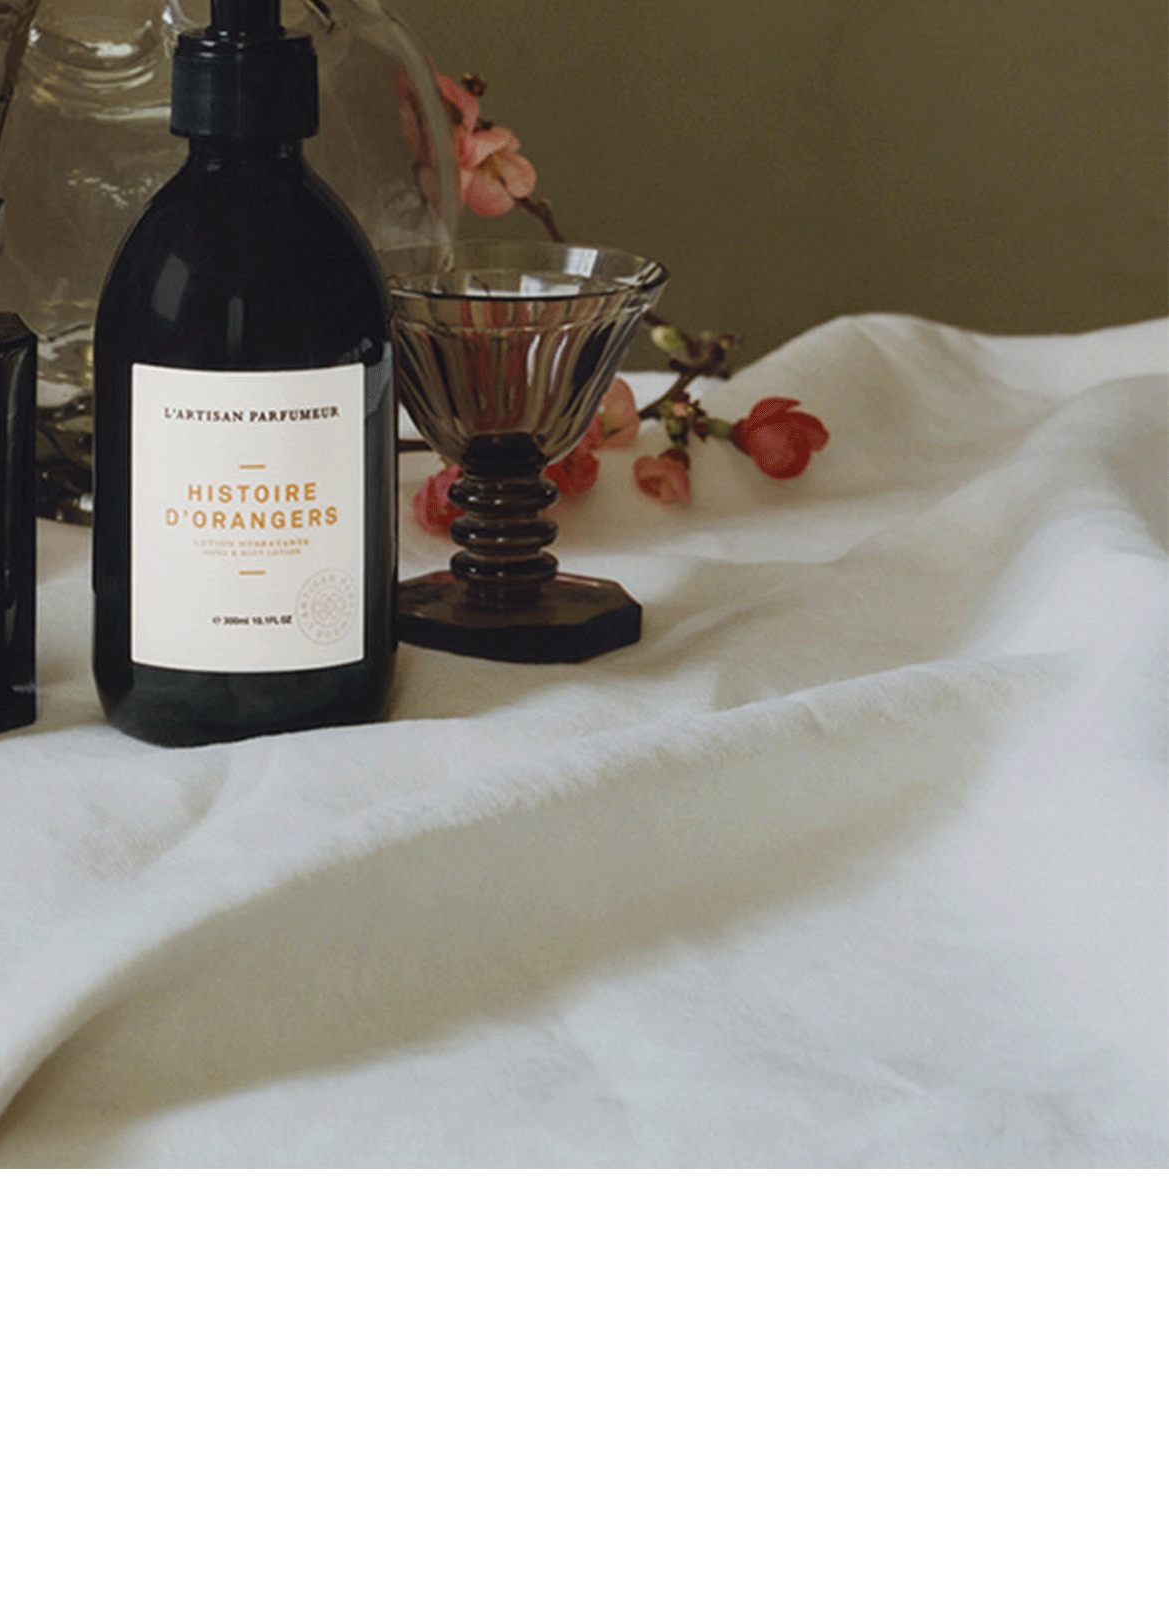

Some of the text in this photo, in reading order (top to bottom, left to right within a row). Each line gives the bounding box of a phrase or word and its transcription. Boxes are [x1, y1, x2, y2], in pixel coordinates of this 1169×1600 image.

[164, 405, 340, 422] L'ARTISAN PARFUMEUR
[188, 482, 317, 504] HISTOIRE
[165, 505, 338, 530] D'ORANGERS
